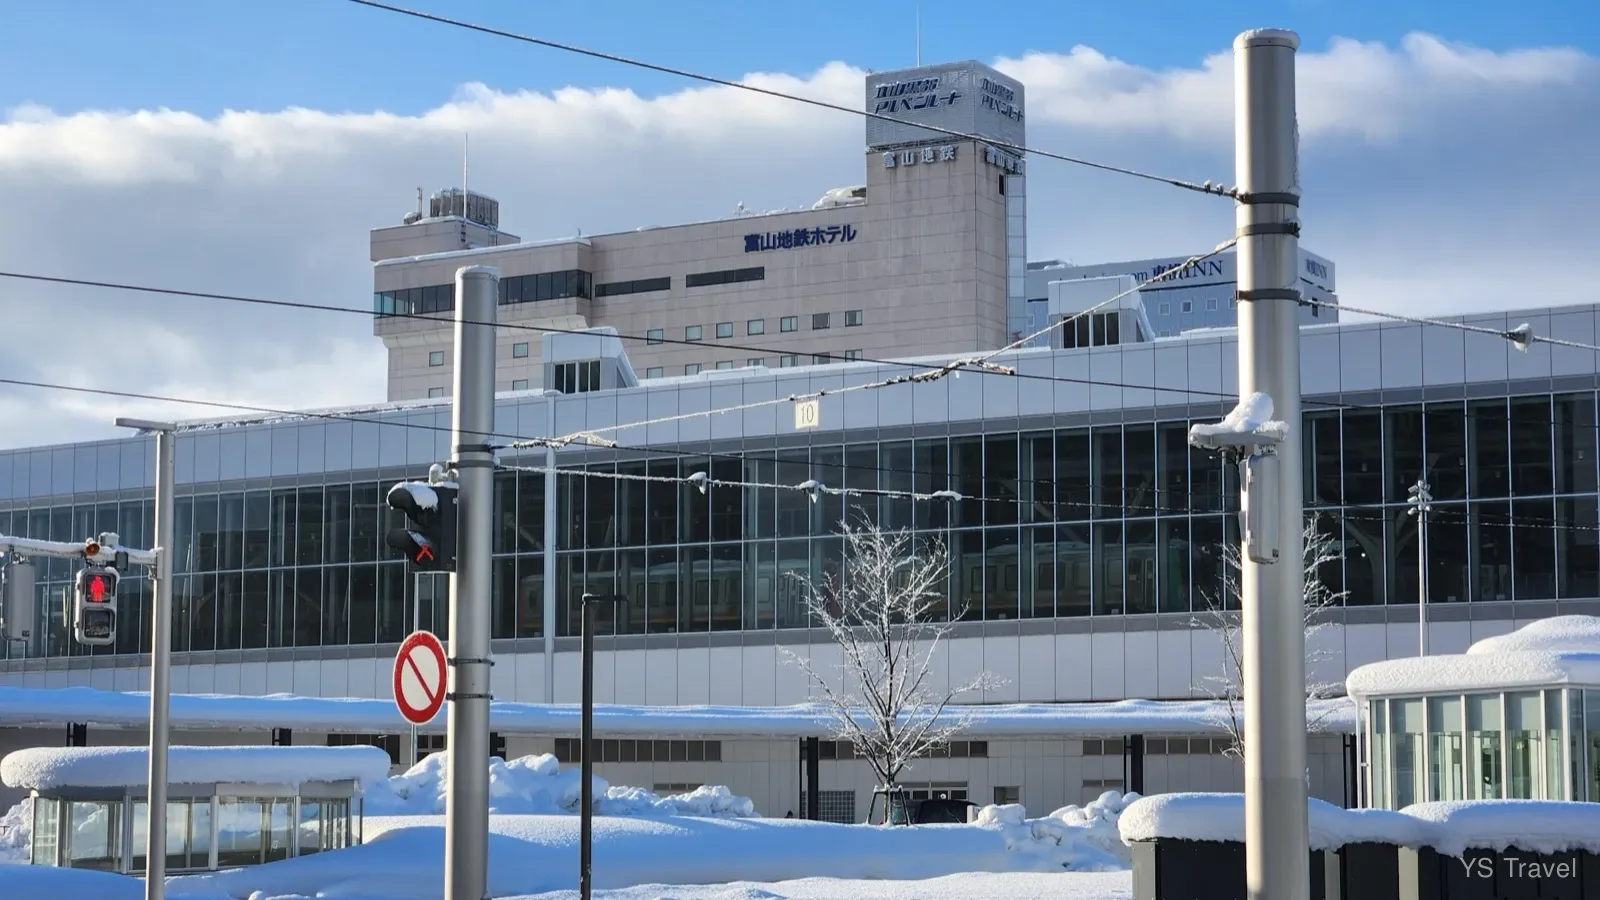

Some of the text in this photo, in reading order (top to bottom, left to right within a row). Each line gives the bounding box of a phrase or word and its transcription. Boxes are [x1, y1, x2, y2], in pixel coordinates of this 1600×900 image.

[744, 224, 857, 253] 富山地鉄ホテル
[801, 403, 814, 425] 10
